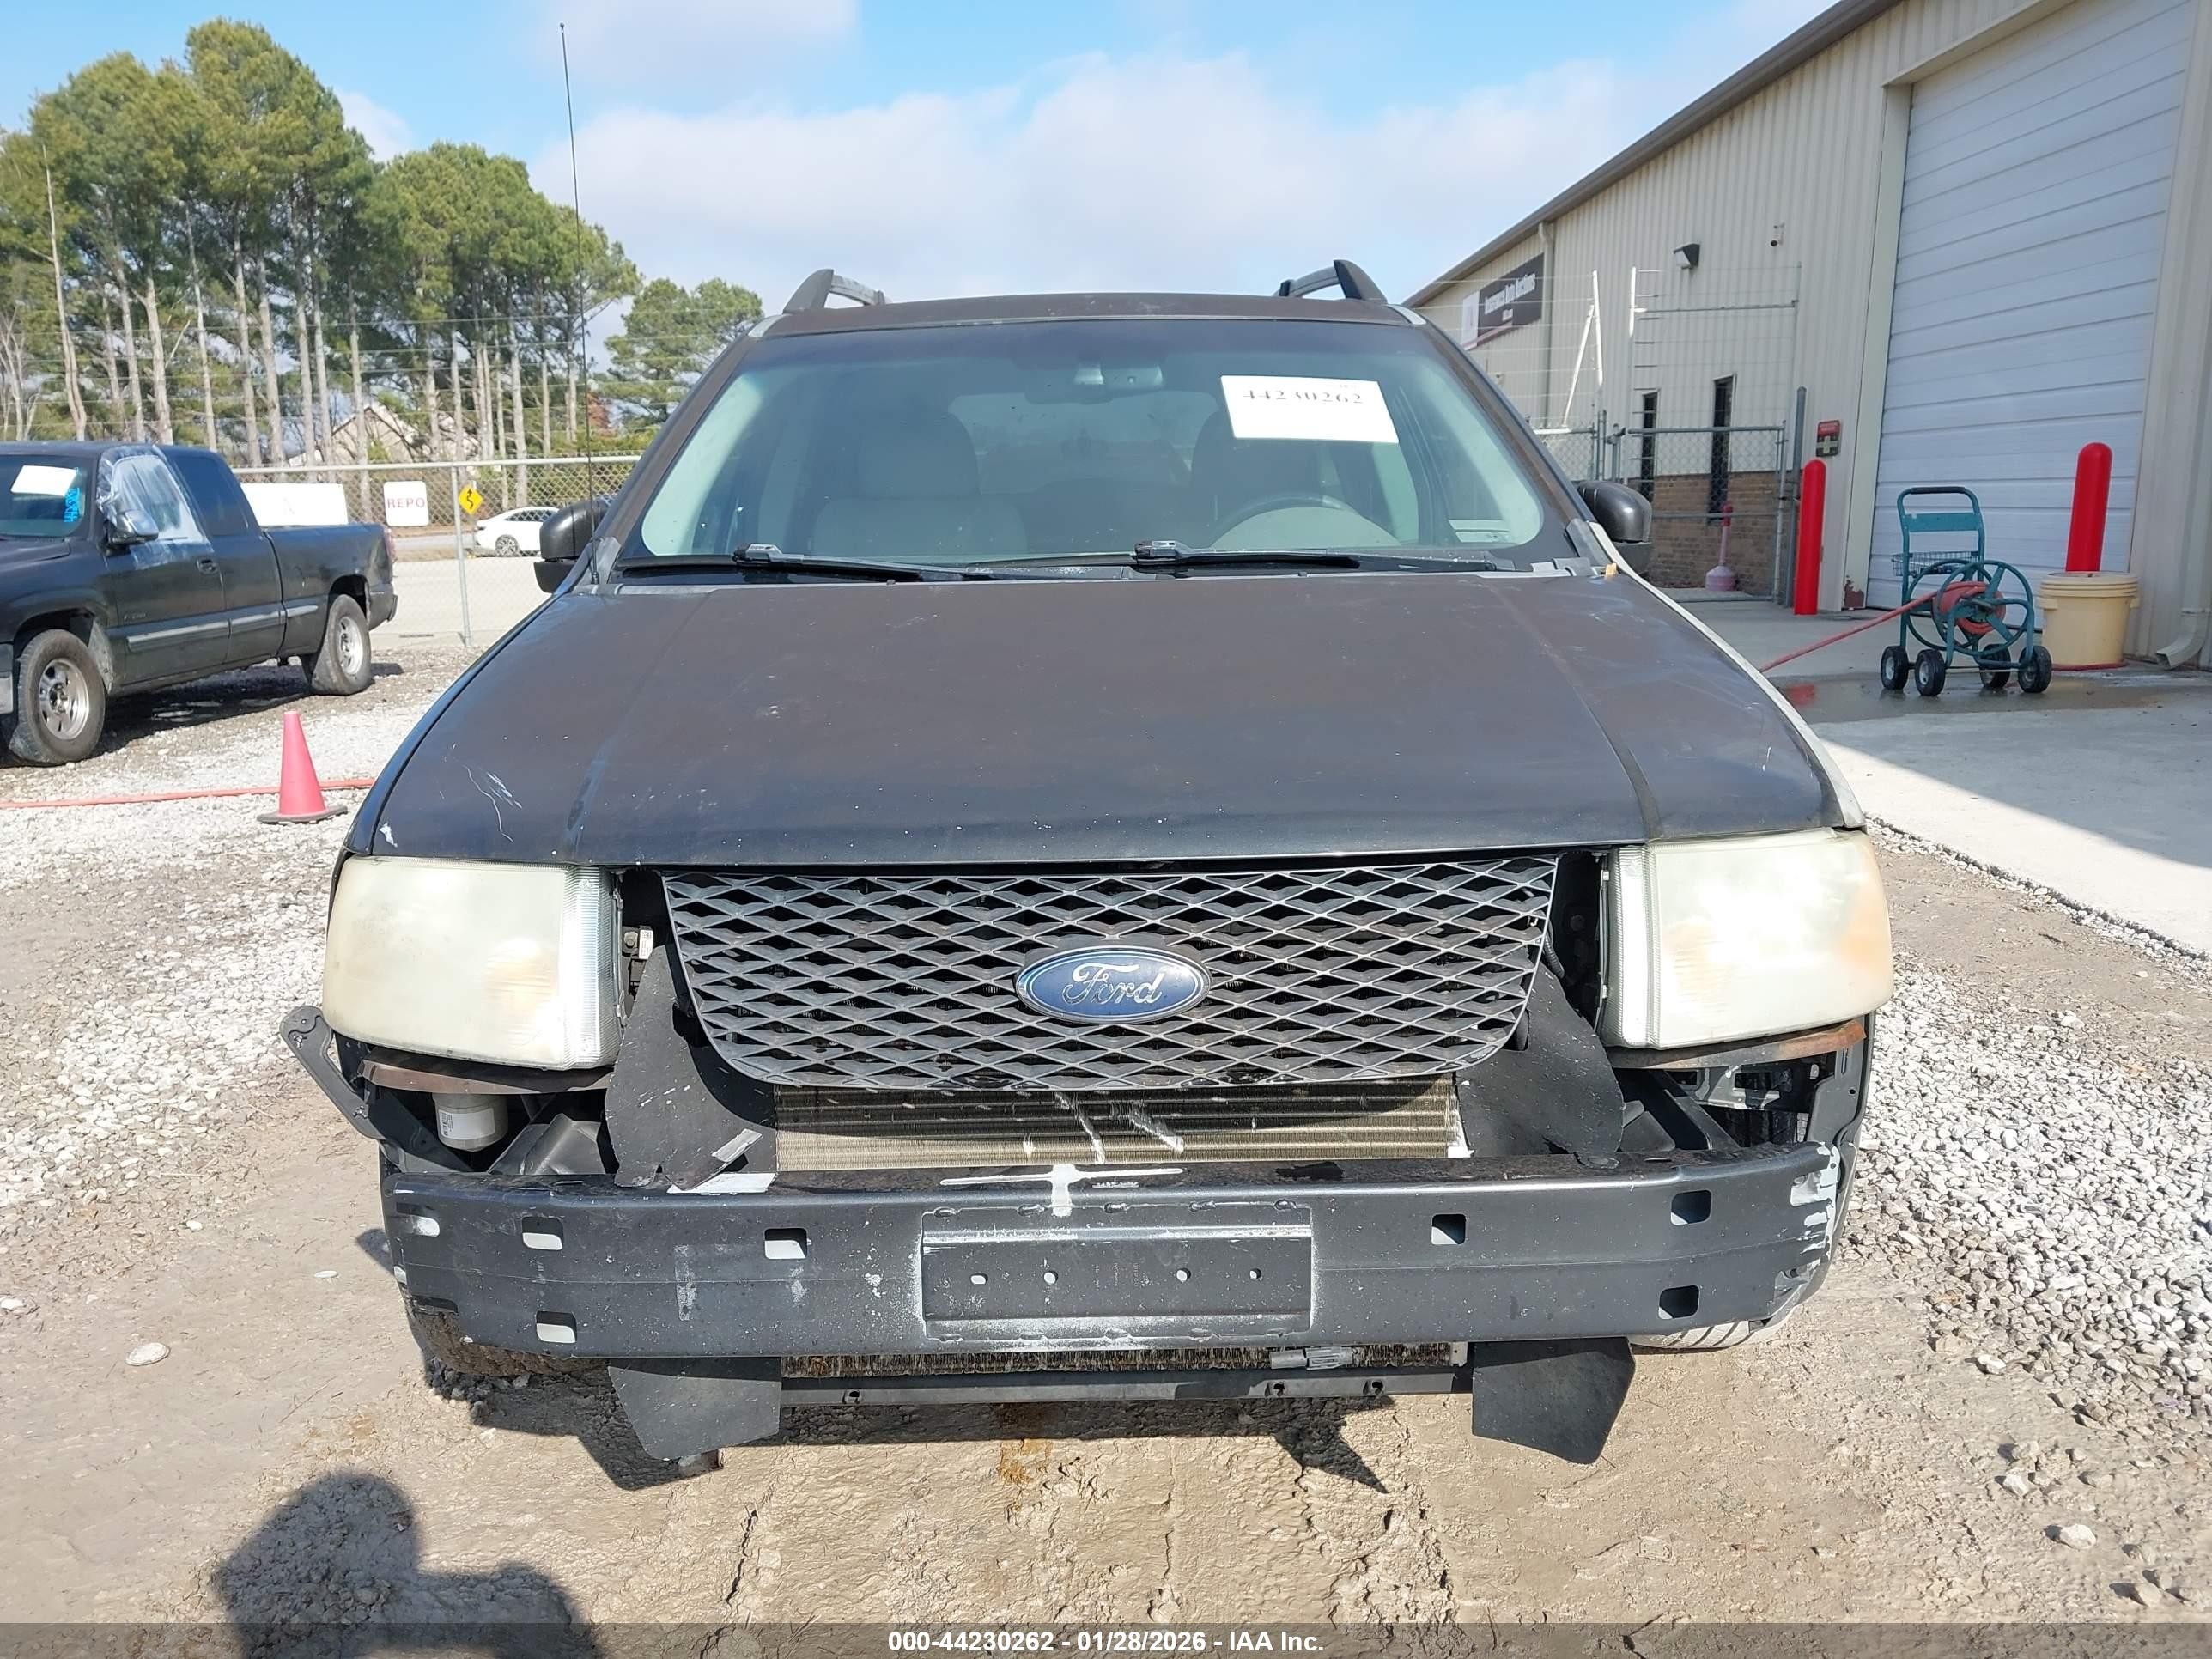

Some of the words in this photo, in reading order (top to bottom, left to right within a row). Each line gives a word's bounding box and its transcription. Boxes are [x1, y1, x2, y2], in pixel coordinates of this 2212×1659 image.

[1242, 388, 1363, 404] 44230262
[387, 497, 425, 508] REPO
[1062, 963, 1165, 1005] Ford
